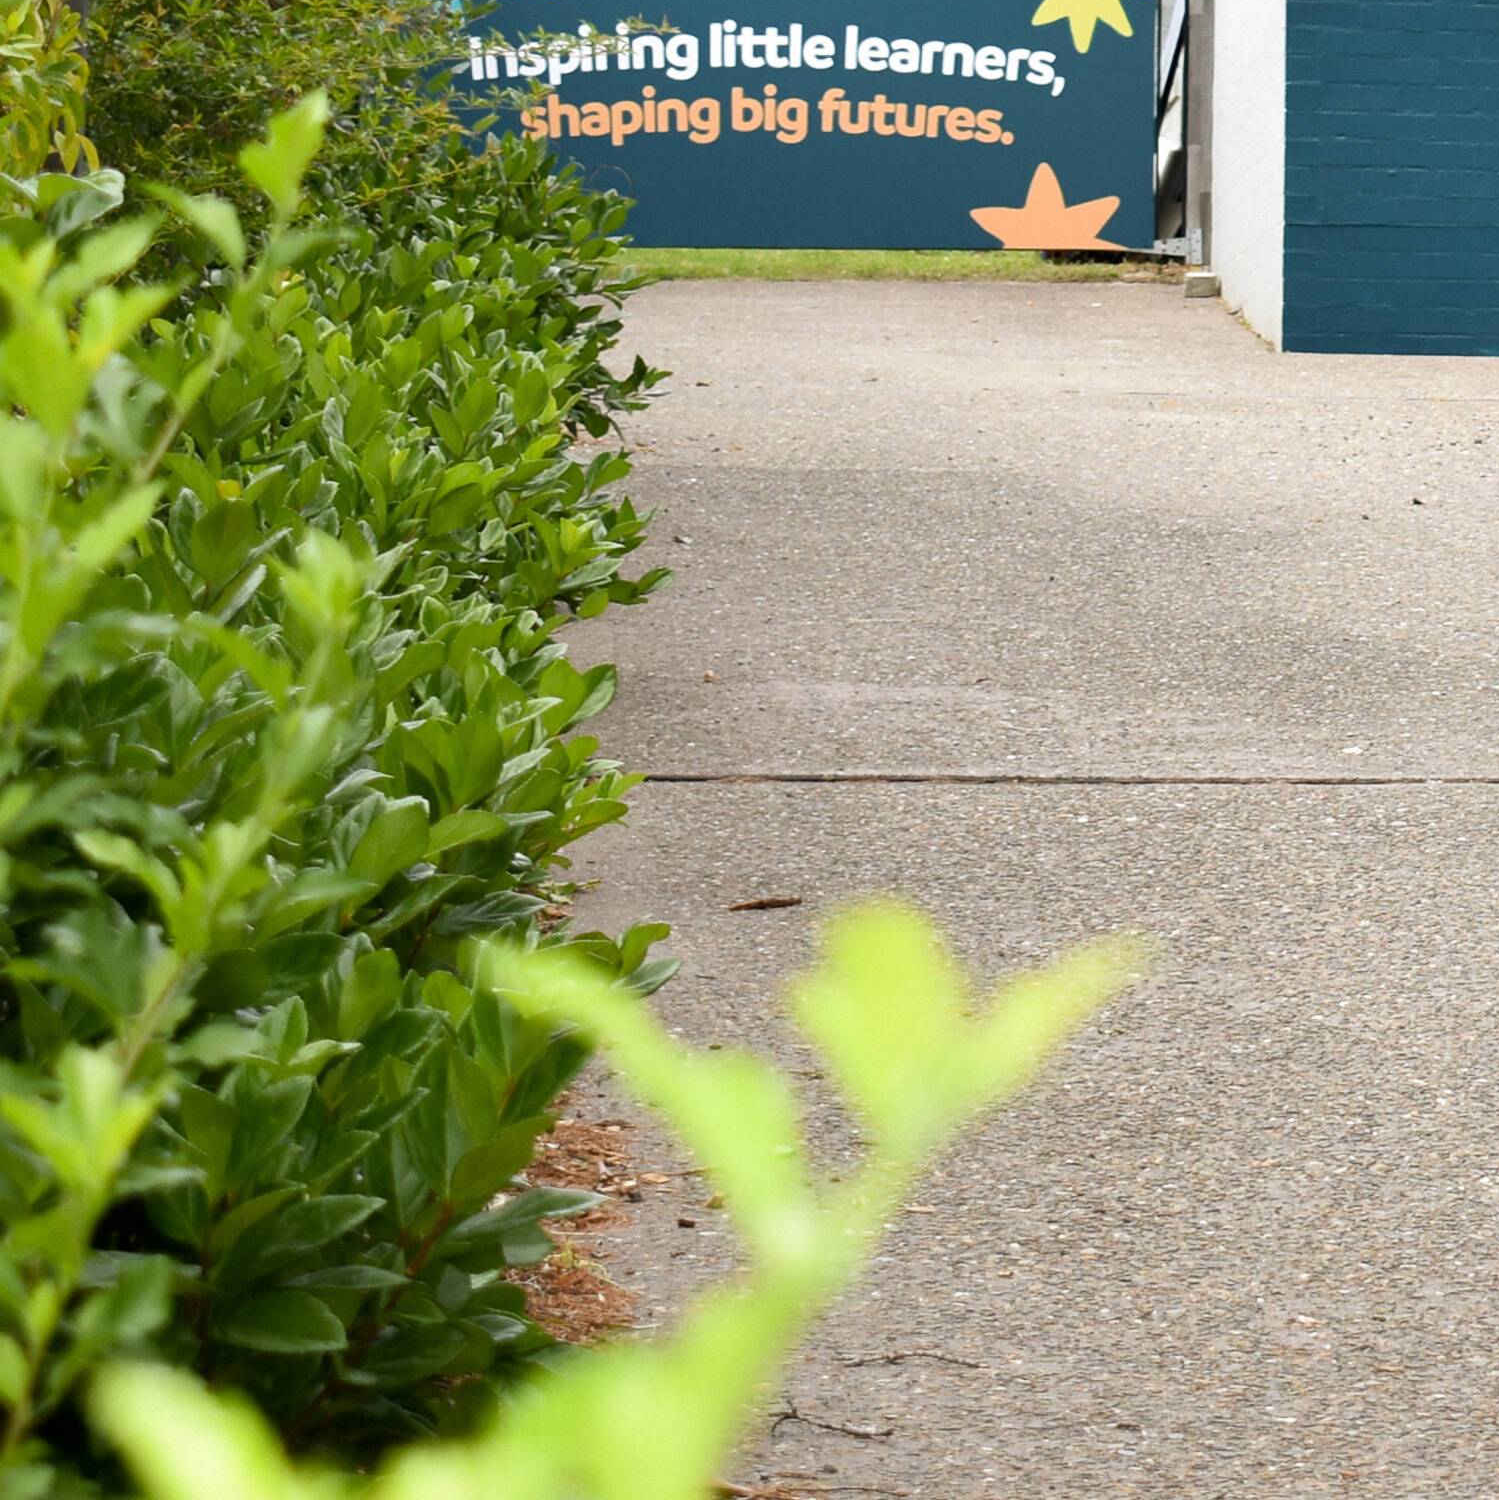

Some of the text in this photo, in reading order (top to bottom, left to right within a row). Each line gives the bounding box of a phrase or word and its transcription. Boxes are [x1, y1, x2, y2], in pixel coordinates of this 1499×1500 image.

[470, 19, 1066, 97] inspiring little learners,
[520, 84, 1014, 146] shaping big futures.
